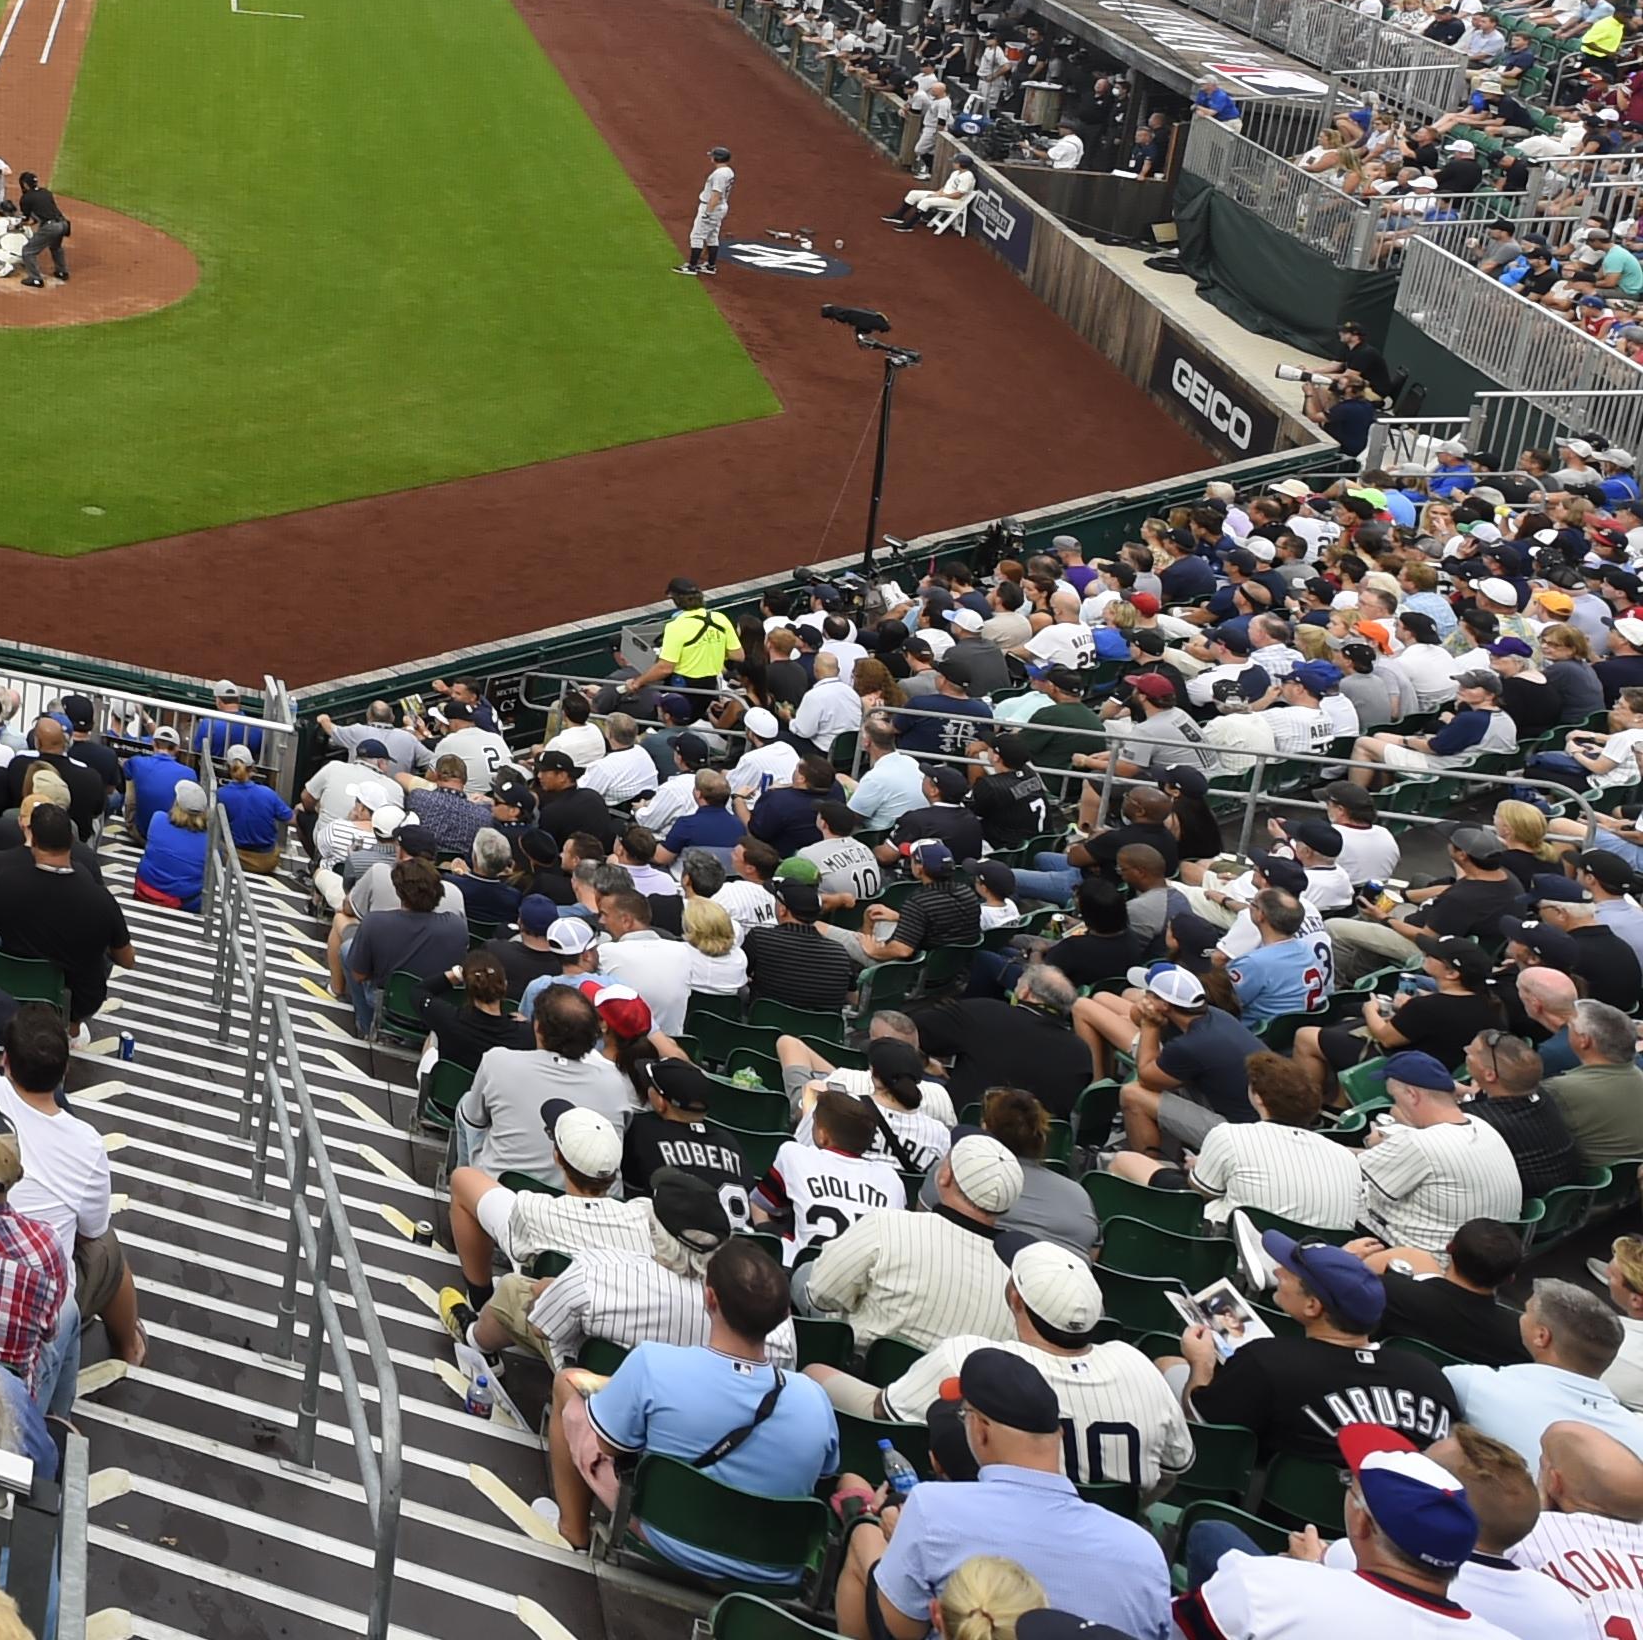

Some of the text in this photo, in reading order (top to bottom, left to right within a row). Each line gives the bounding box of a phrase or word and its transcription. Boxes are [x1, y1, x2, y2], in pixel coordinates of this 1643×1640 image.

[1172, 358, 1253, 450] GEICO
[500, 699, 515, 712] C5
[484, 748, 501, 773] 2
[1028, 797, 1046, 833] 7
[852, 868, 878, 899] 10
[657, 1140, 742, 1178] ROBERT
[1301, 1386, 1453, 1438] LARUSSA
[1059, 1417, 1141, 1481] 10
